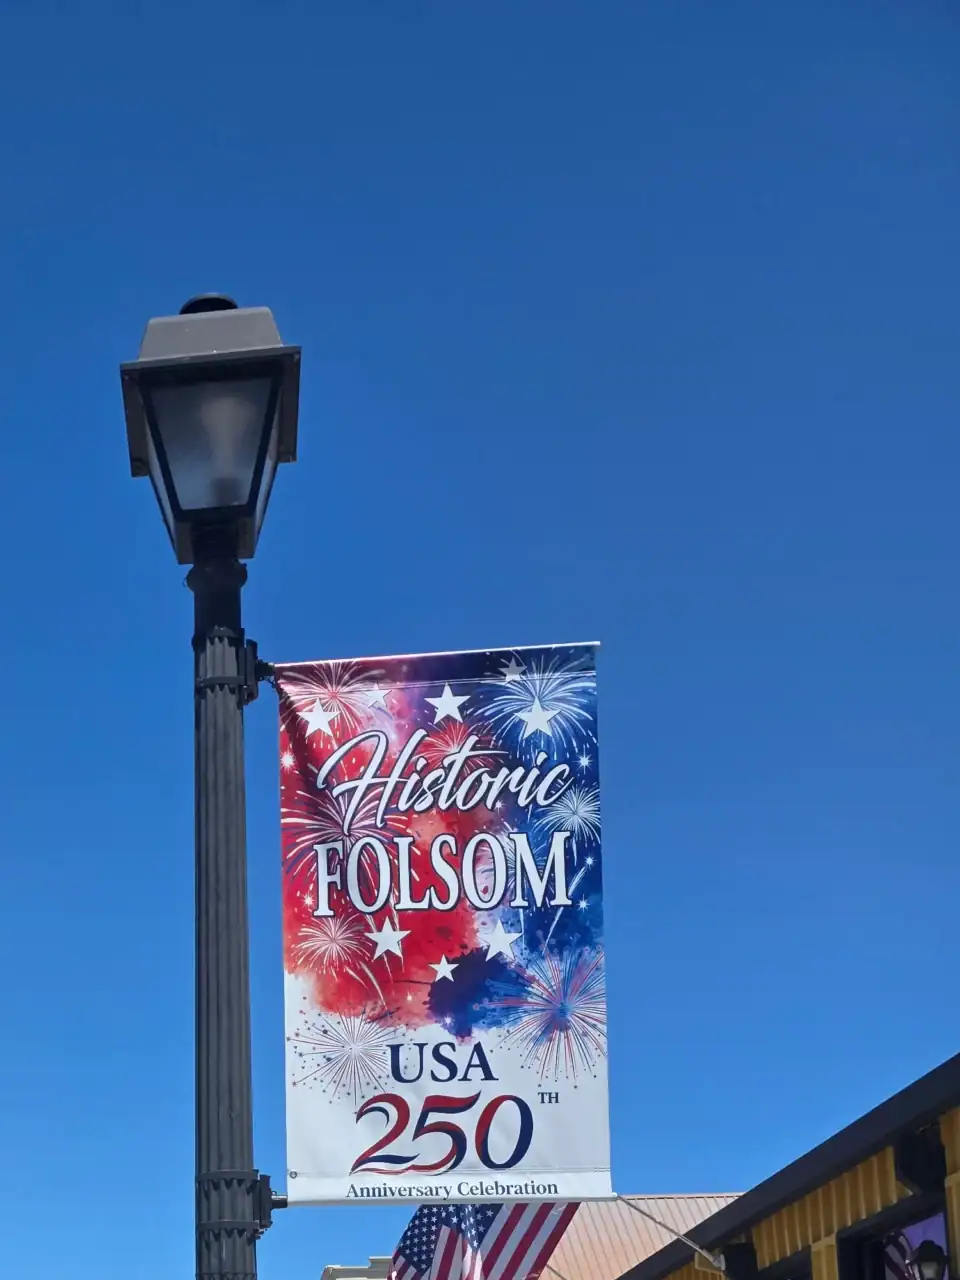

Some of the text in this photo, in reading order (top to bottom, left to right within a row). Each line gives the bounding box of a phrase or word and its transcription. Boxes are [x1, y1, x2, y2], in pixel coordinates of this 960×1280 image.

[316, 728, 575, 836] Historic
[313, 831, 573, 917] FOLSOM
[387, 1041, 499, 1083] USA
[350, 1091, 560, 1176] 250 TH
[345, 1179, 559, 1200] Anniversary Celebration
